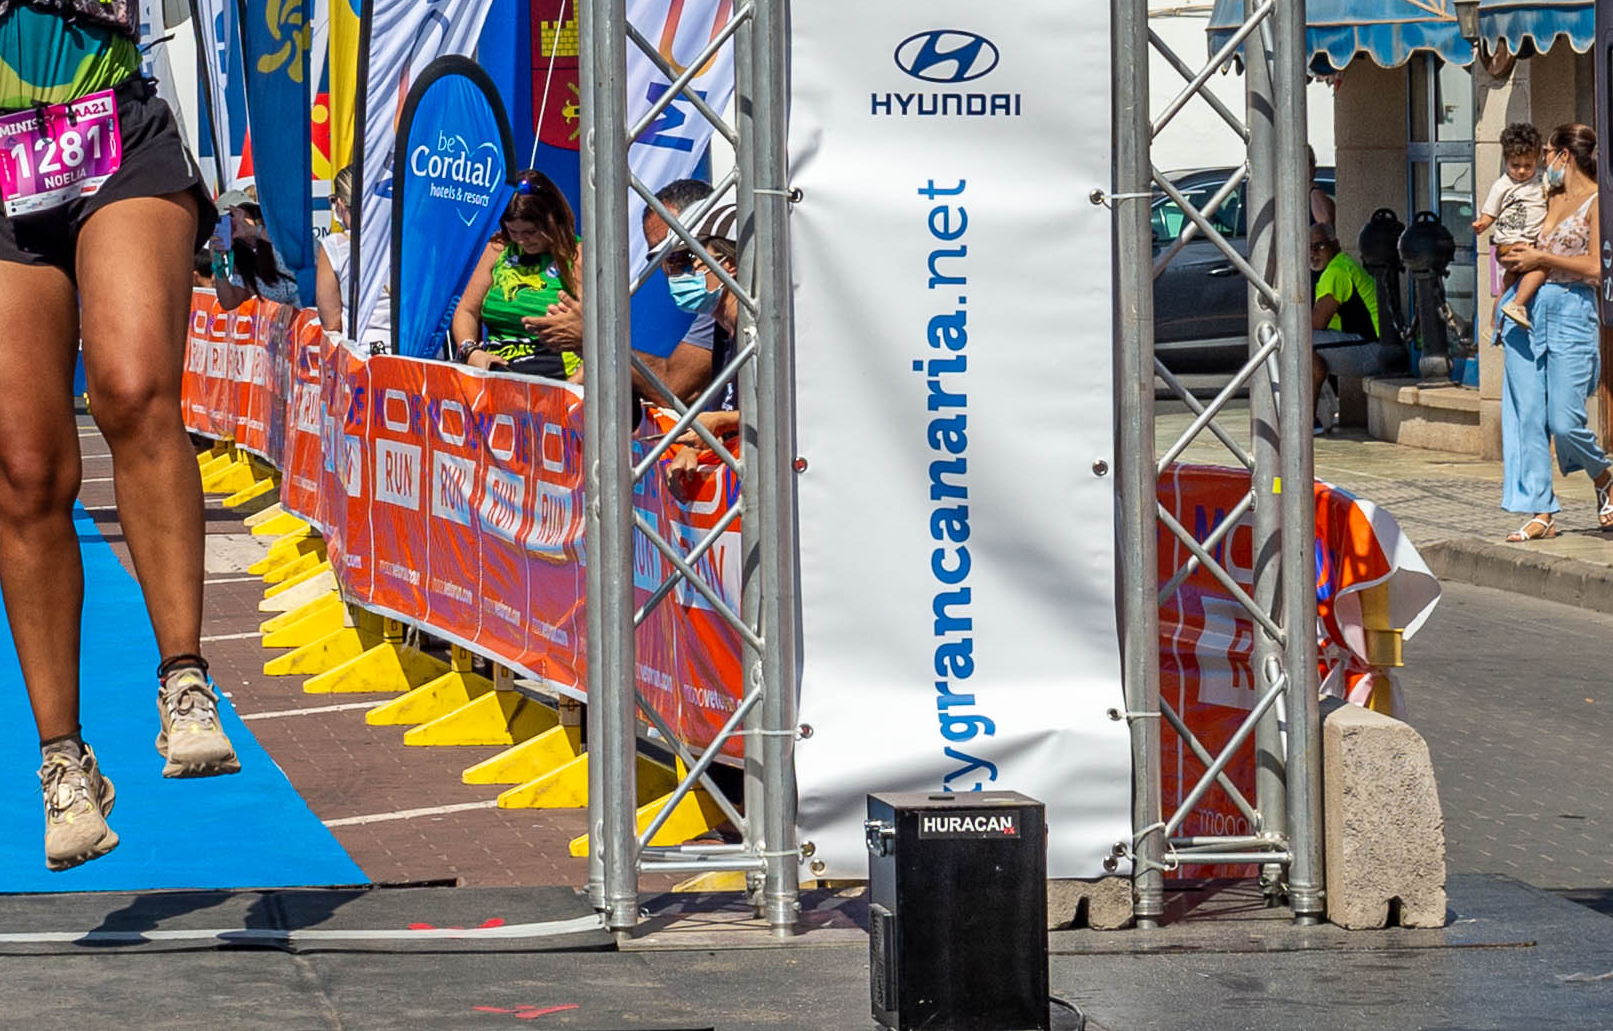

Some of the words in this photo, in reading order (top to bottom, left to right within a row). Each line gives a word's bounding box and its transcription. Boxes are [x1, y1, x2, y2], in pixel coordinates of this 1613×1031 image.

[871, 93, 1021, 115] HYUNDAI
[10, 125, 101, 178] 1281
[438, 130, 455, 153] be
[411, 145, 493, 188] Cordial
[43, 168, 87, 189] NOELIA
[430, 183, 455, 200] hotels
[456, 187, 463, 201] &
[463, 190, 490, 207] resorts
[385, 449, 412, 498] RUN
[924, 816, 1012, 834] HURACAN
